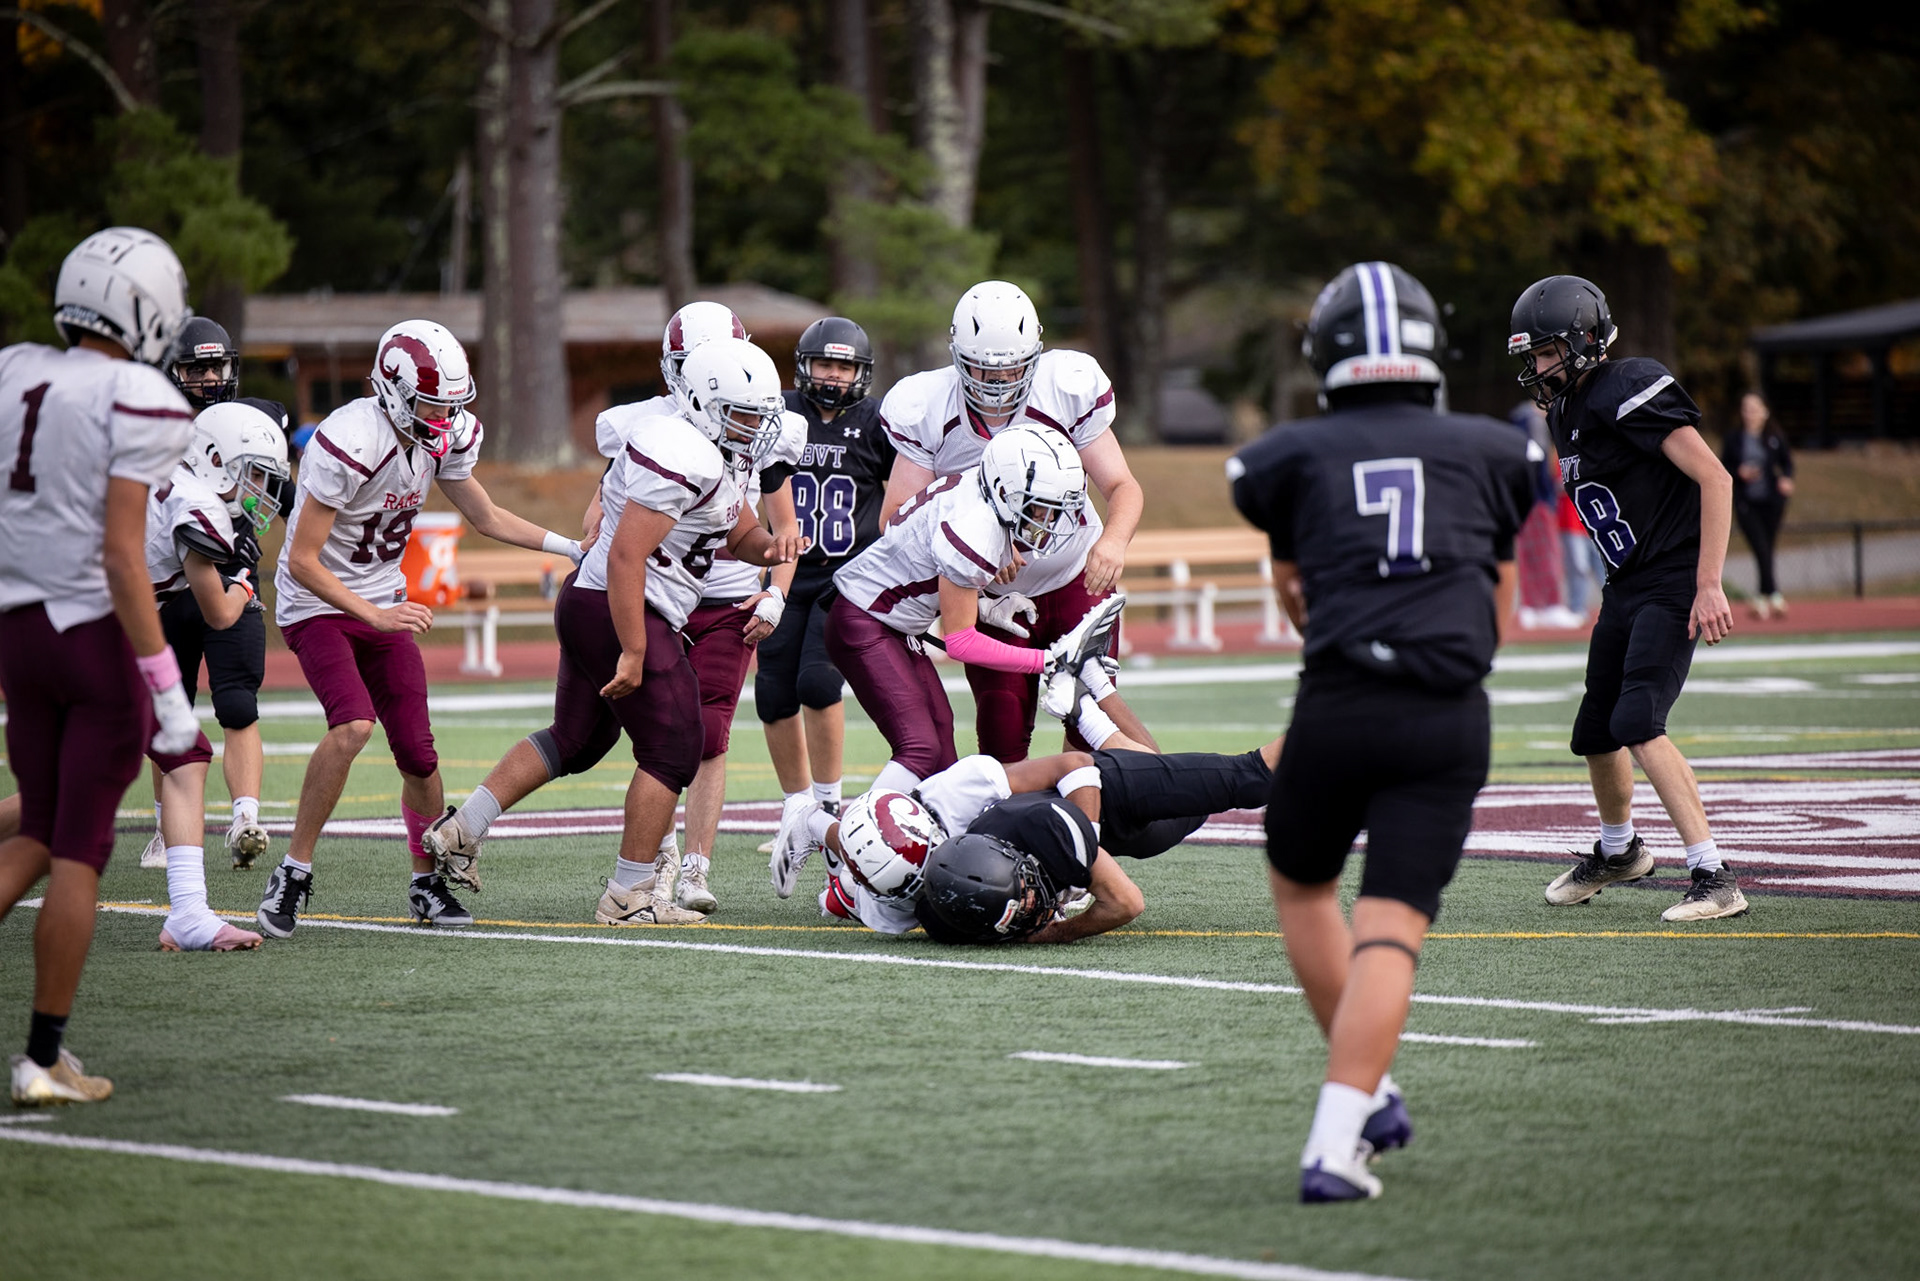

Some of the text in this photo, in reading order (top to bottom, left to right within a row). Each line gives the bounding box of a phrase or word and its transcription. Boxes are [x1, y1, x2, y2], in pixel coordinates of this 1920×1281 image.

[9, 381, 52, 493] 1
[801, 443, 847, 468] BVT
[383, 490, 421, 510] RAMS
[790, 471, 857, 556] 88
[1353, 457, 1431, 578] 7
[350, 508, 418, 564] 19
